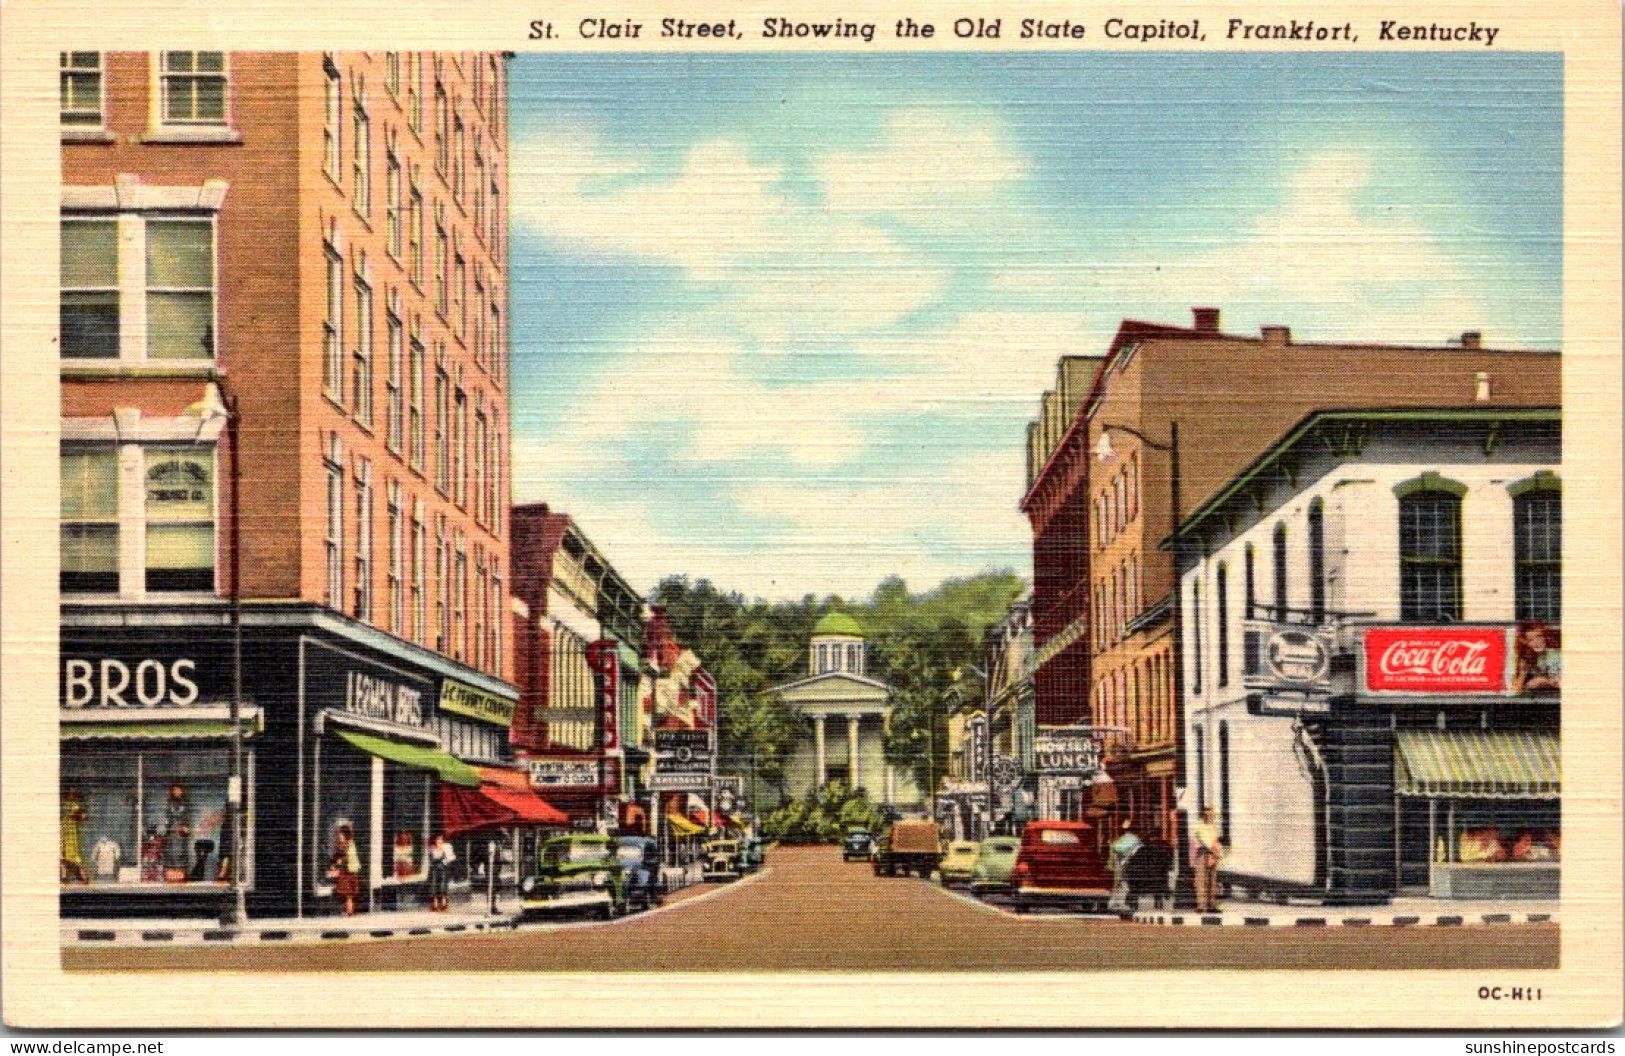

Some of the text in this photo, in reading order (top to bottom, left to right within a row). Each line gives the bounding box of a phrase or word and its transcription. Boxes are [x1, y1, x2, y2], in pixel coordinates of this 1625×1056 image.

[1380, 639, 1490, 675] Coca-Cola
[66, 658, 199, 706] BROS
[1039, 753, 1099, 768] LUNCH
